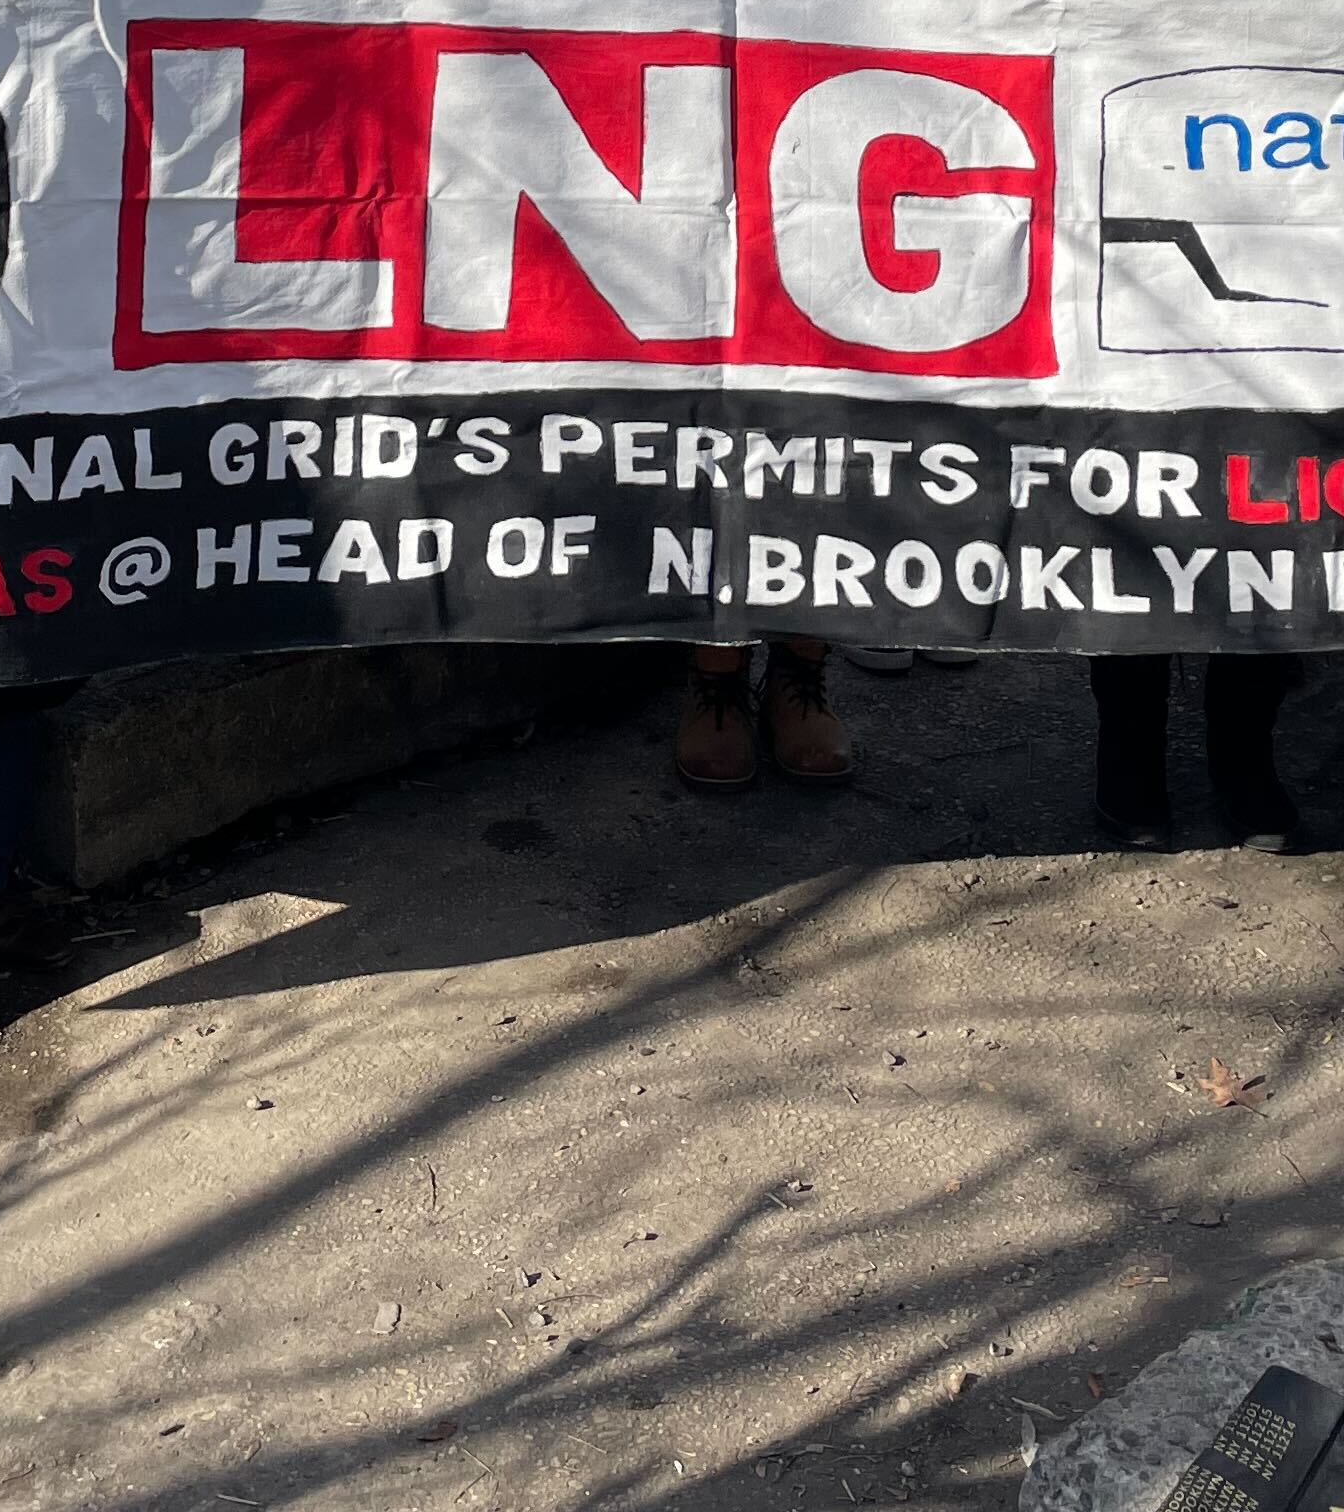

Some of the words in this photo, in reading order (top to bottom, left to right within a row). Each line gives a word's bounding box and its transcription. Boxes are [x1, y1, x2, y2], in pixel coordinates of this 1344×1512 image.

[140, 45, 1037, 352] LNG
[208, 413, 512, 487] GRID'S
[538, 414, 981, 508] PERMITS
[1009, 445, 1202, 519] FOR
[98, 535, 172, 608] @
[194, 516, 455, 590] HEAD
[486, 514, 598, 579] OF
[1225, 1440, 1241, 1459] NY
[1236, 1402, 1261, 1440] 11201
[1238, 1447, 1253, 1465] NY
[1248, 1408, 1273, 1447] 11215
[1249, 1453, 1265, 1473] NY
[1260, 1414, 1285, 1453] 11215
[1261, 1460, 1277, 1481] NY
[1272, 1421, 1296, 1460] 11214
